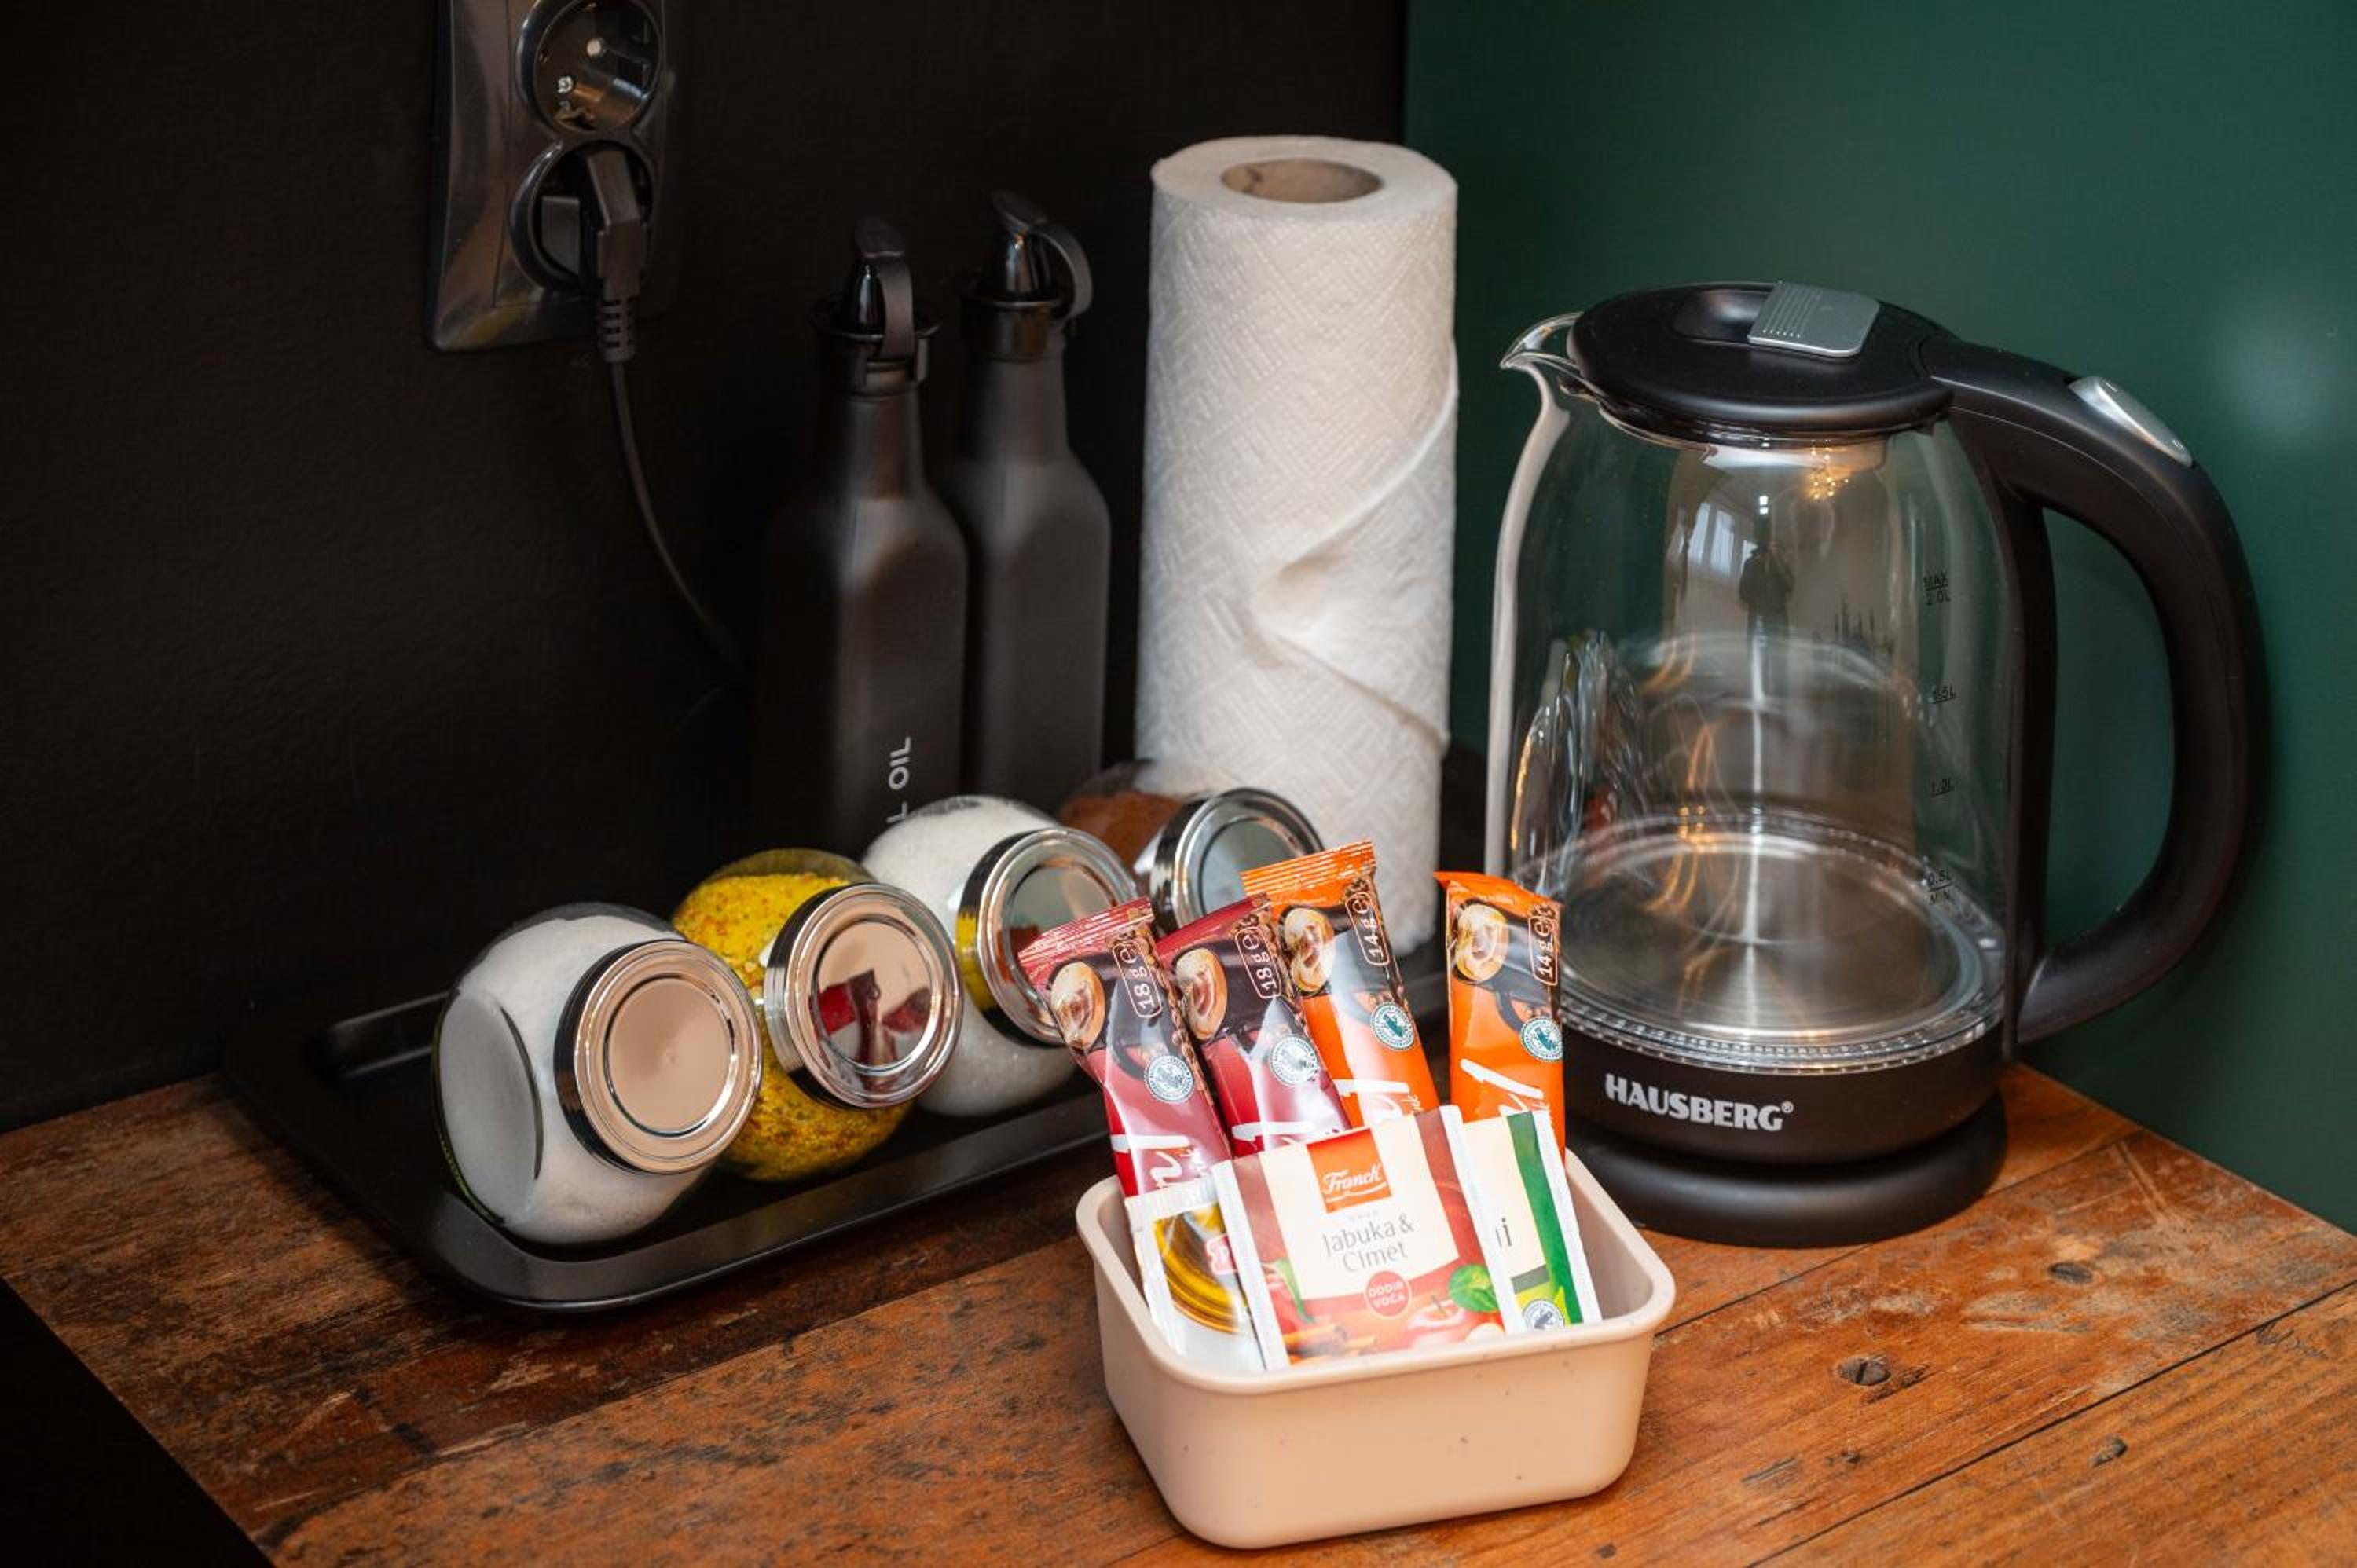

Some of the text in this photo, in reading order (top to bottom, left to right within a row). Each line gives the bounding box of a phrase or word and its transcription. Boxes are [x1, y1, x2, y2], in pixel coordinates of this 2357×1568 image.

[1923, 575, 1949, 590] MAX
[889, 736, 911, 790] OIL
[1251, 951, 1270, 962] g
[1364, 931, 1384, 959] 14
[1130, 966, 1147, 978] g
[1257, 967, 1278, 991] 18
[1537, 955, 1554, 979] 14
[1134, 983, 1156, 1009] 18
[1322, 1162, 1383, 1195] Franck
[1322, 1220, 1396, 1257] Jabuka
[1398, 1213, 1415, 1234] &
[1343, 1241, 1409, 1273] Cimet
